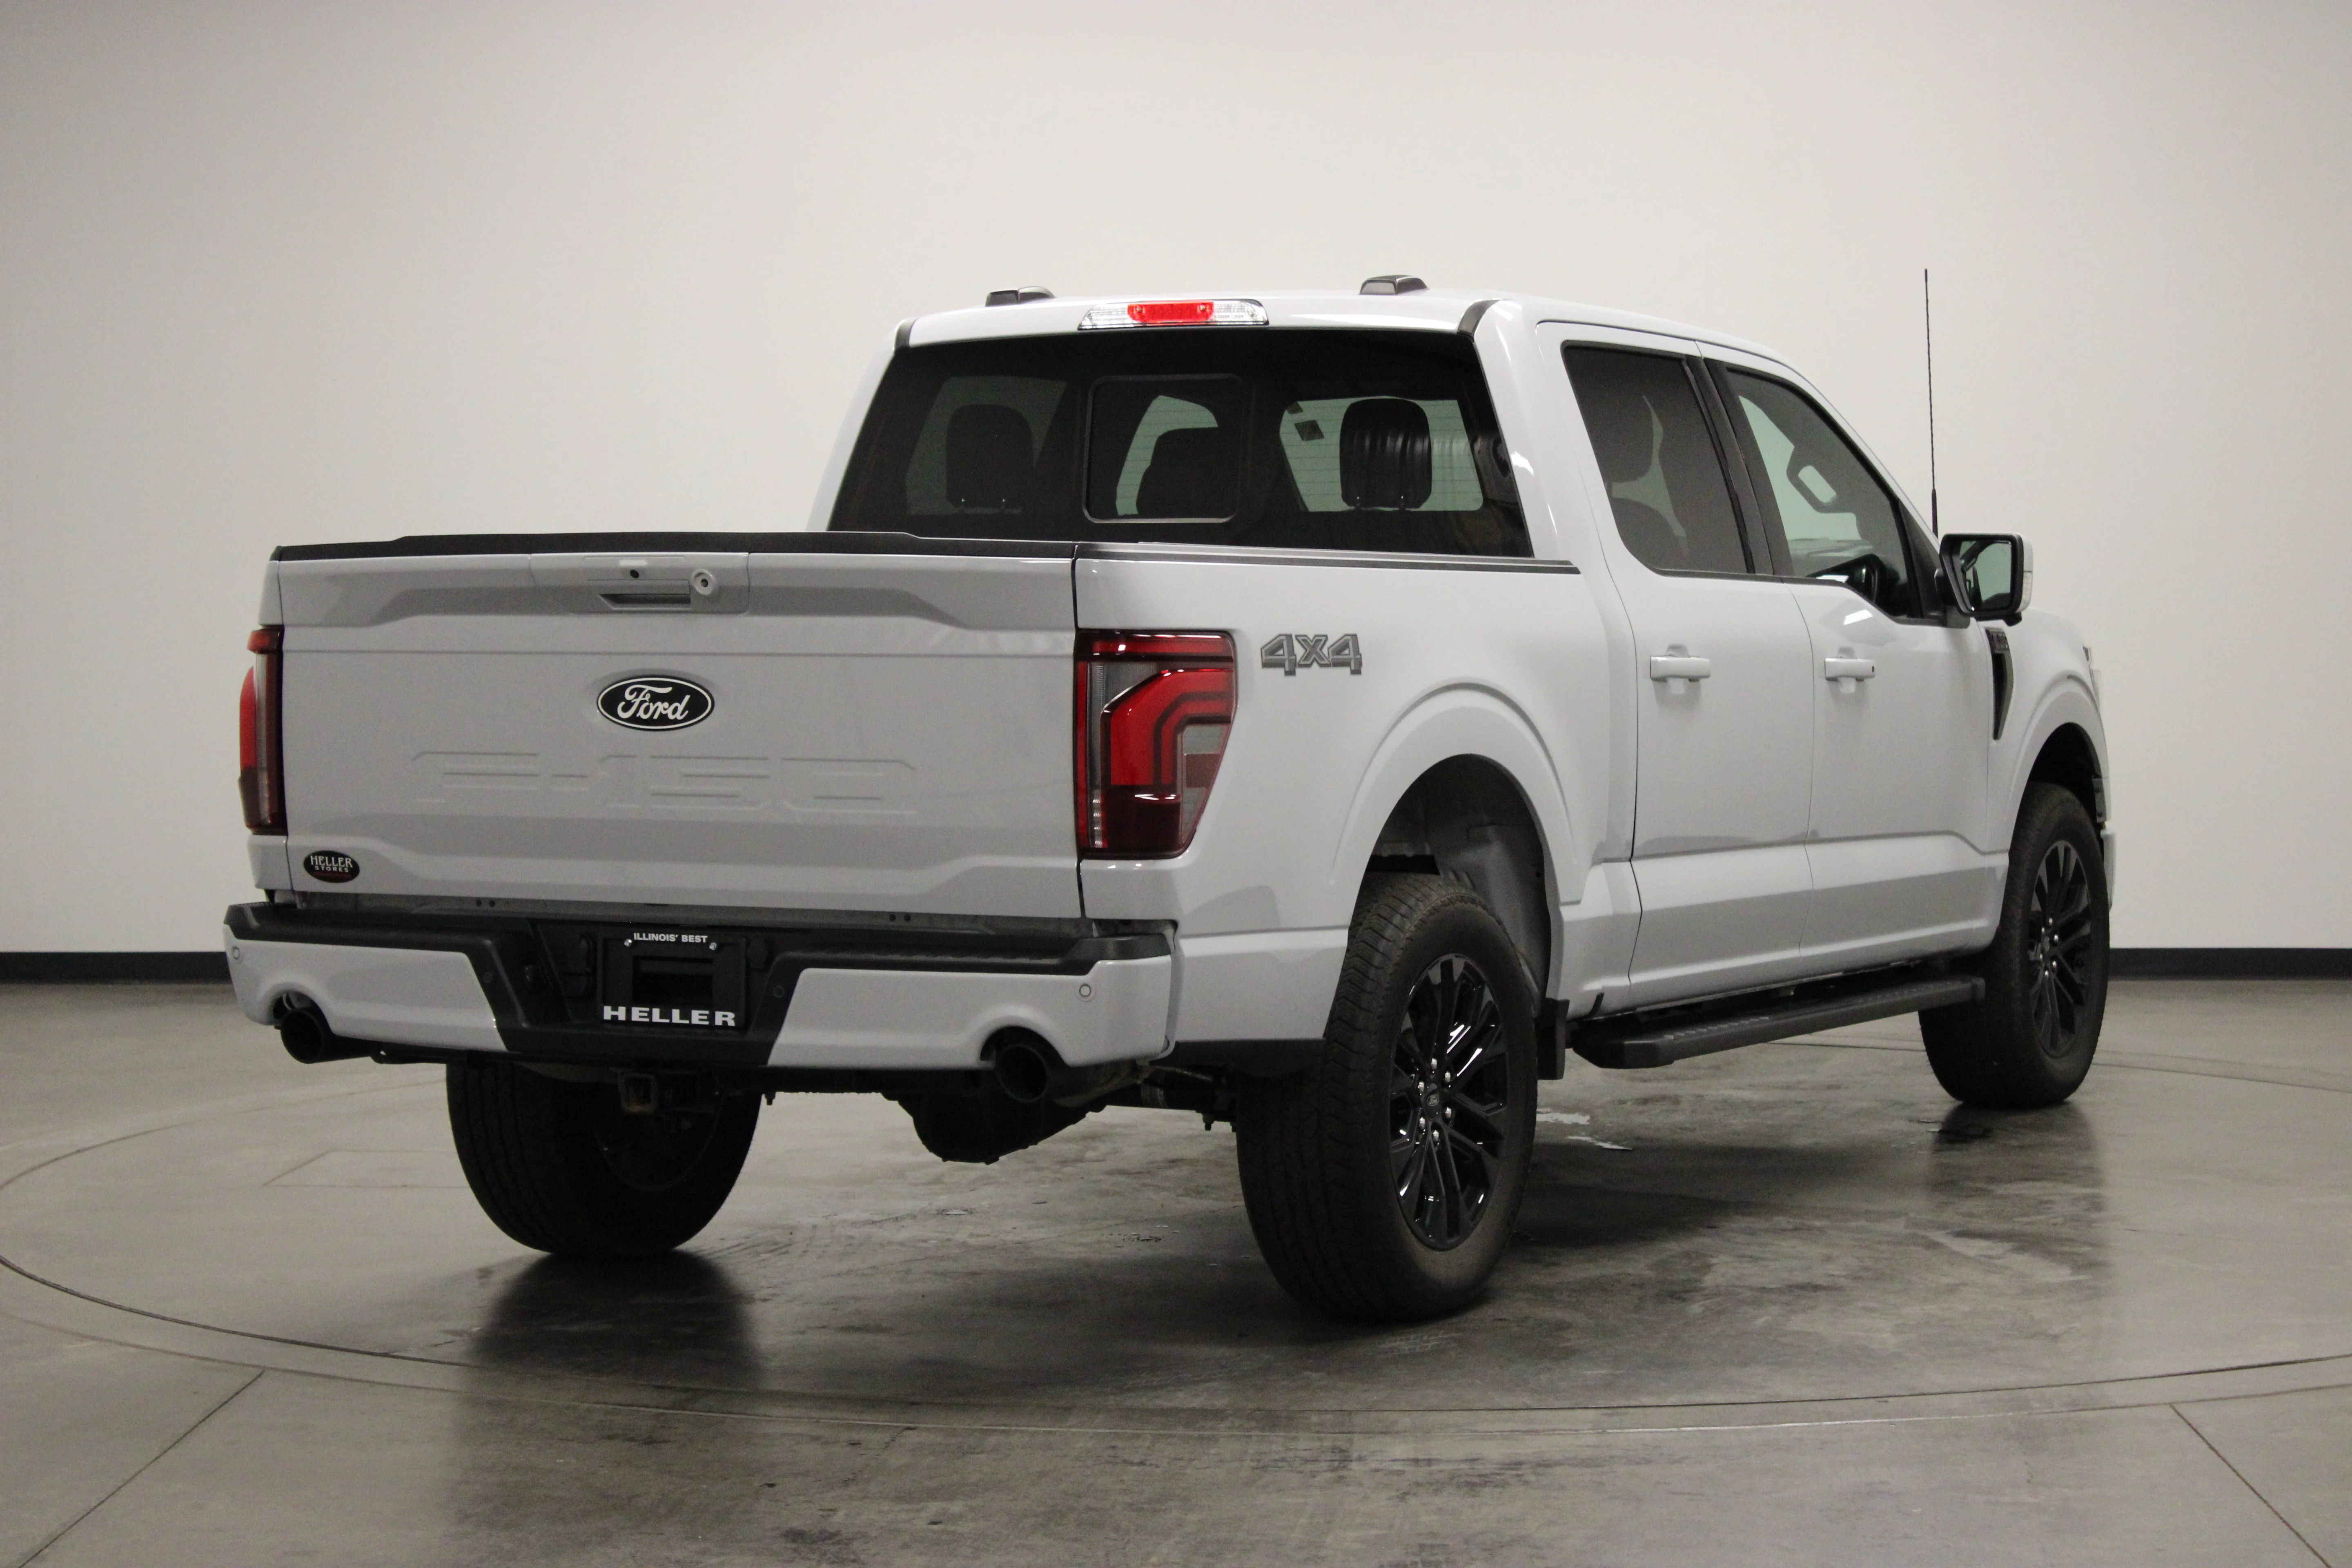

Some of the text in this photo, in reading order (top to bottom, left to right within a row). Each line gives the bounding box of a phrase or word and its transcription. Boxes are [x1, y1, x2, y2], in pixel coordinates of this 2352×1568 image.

[617, 684, 690, 720] Ford
[310, 855, 353, 868] HELLER
[681, 934, 708, 943] BEST
[603, 1006, 736, 1027] HELLER
